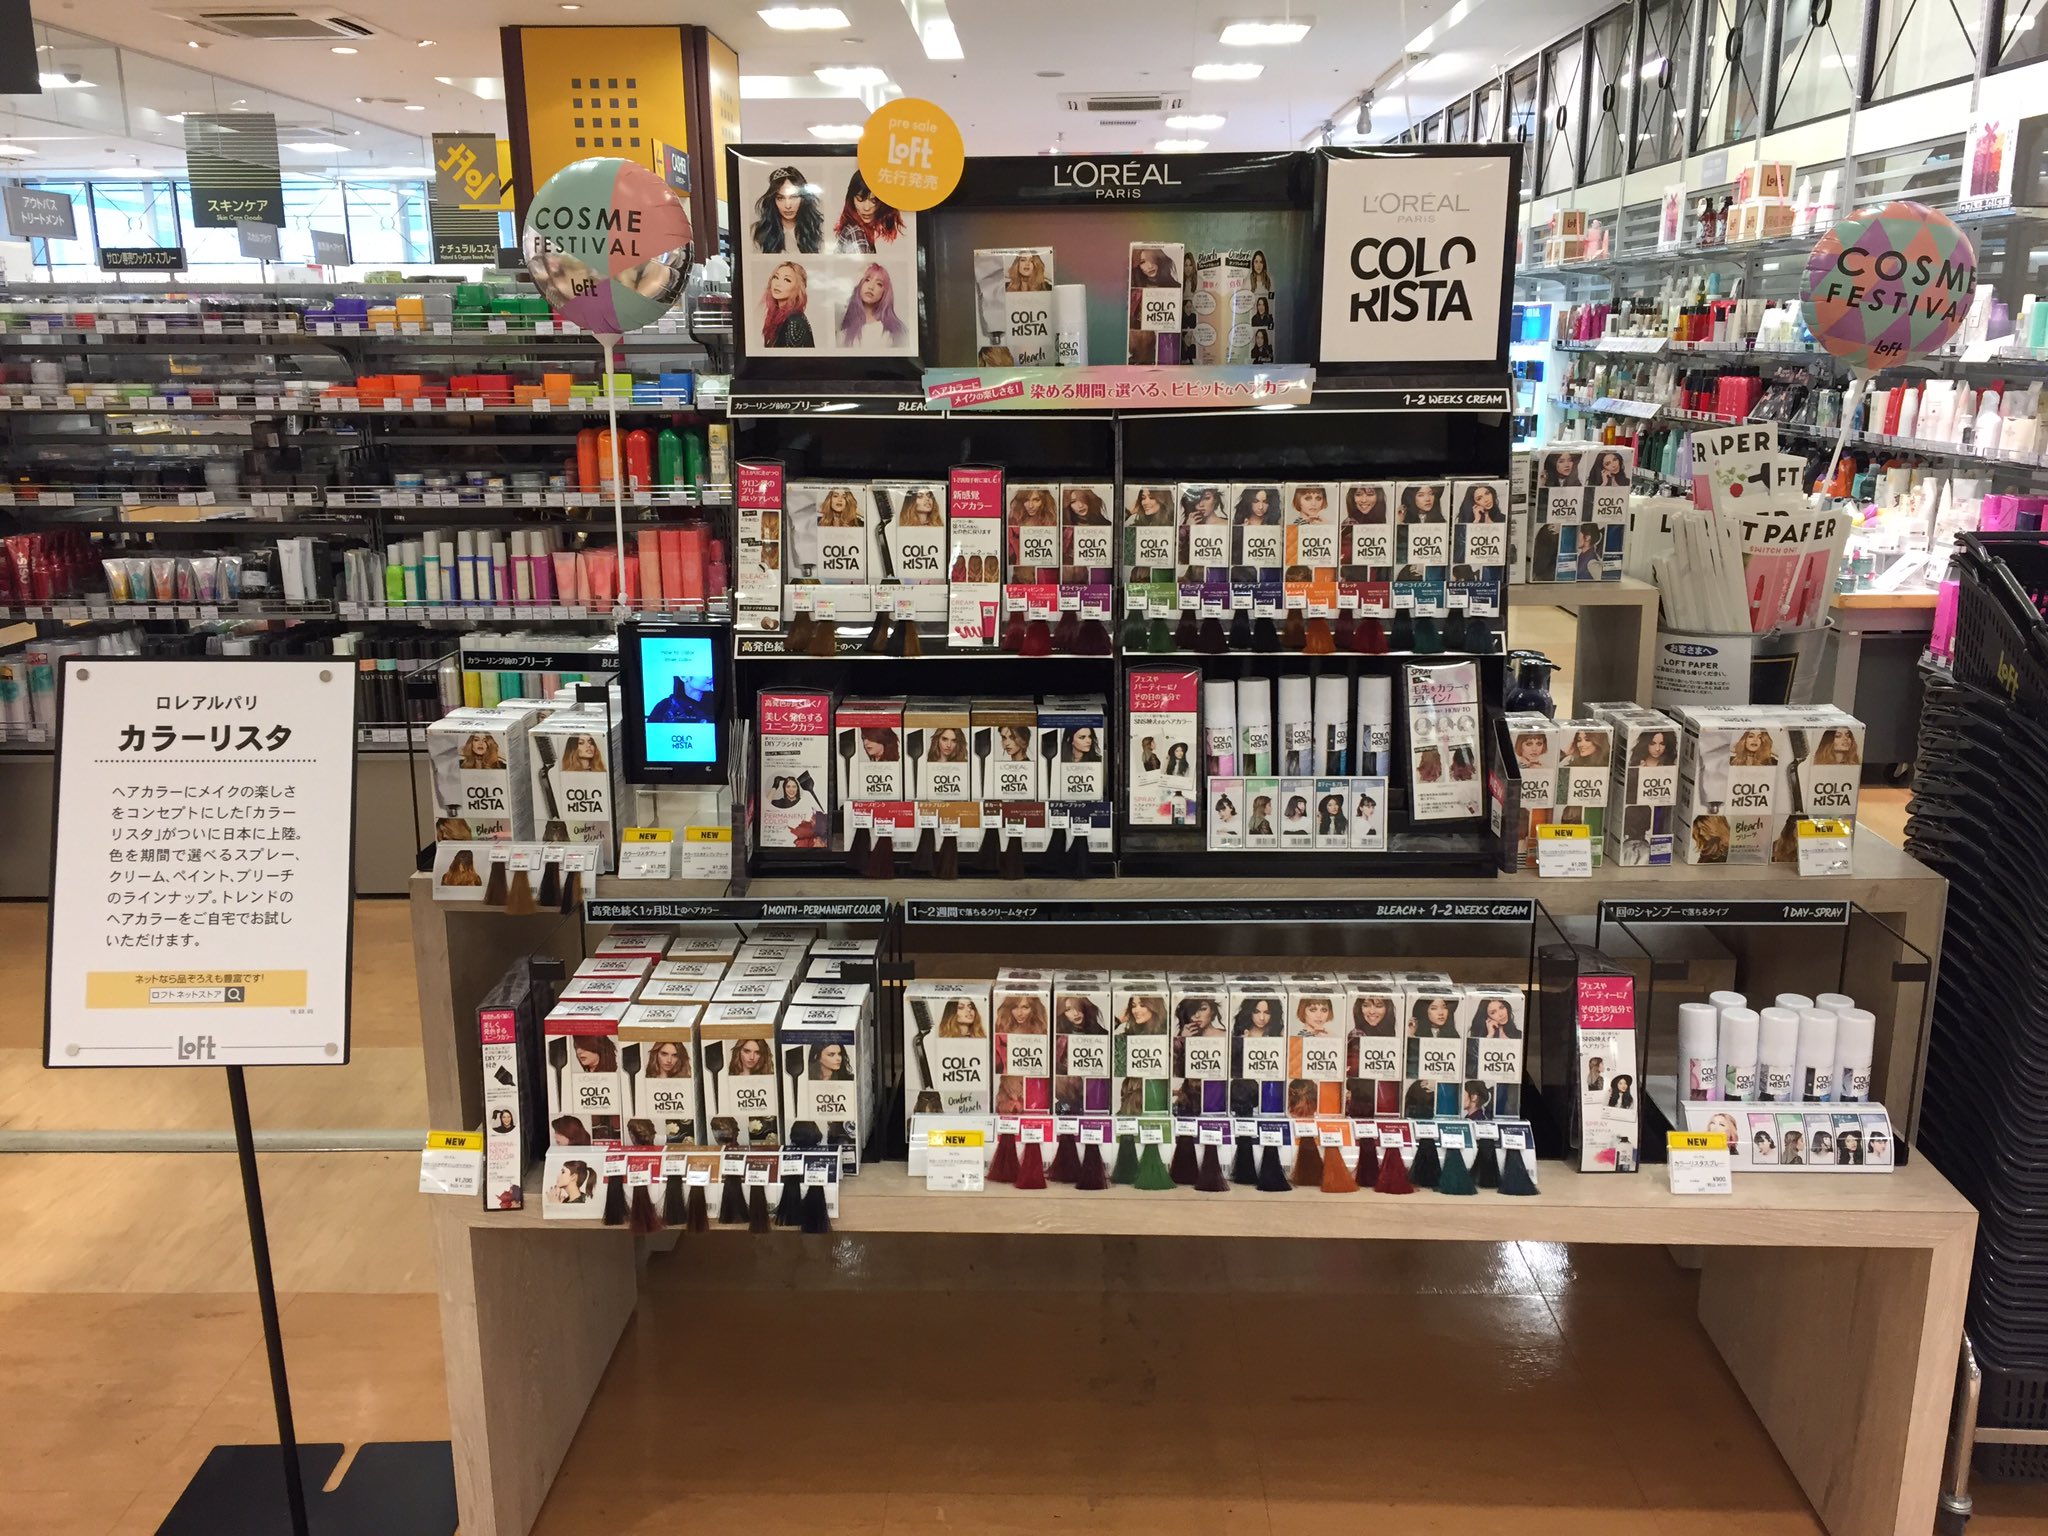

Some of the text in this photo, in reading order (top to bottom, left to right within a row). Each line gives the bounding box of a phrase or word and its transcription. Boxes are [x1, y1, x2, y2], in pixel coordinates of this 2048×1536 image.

[888, 118, 938, 134] pre sale
[878, 167, 939, 190] 先行発売
[1054, 161, 1182, 188] L'ORÉAL
[22, 196, 58, 211] アウトバス
[208, 200, 268, 212] スキンケア
[1363, 192, 1470, 214] L'ORÉAL
[21, 212, 65, 227] トリートメント
[535, 206, 641, 233] COSME
[534, 236, 640, 257] FESTIVAL
[1351, 236, 1476, 280] COLO
[1837, 247, 1976, 295] COSME
[1146, 301, 1176, 312] COLO
[1350, 280, 1473, 322] RISTA
[1010, 311, 1048, 324] COLO
[1403, 394, 1503, 406] 1-2 WEEKS CREAM
[952, 490, 980, 500] 新感覚
[952, 502, 992, 511] ヘアカラー
[1669, 644, 1713, 655] お客さまへ
[467, 656, 553, 667] カラーリング前のブリーチ
[1664, 658, 1719, 669] LOFT PAPER
[1134, 675, 1159, 683] フェスや
[156, 695, 258, 711] ロレアルパリ
[765, 712, 823, 722] 美しく発色する
[765, 722, 824, 732] ユニークカラー
[118, 724, 292, 752] カラーリスタ
[111, 785, 297, 799] ヘアカラーにメイクの楽しさ
[466, 787, 503, 798] COLO
[566, 789, 602, 800] COLO
[1732, 783, 1770, 796] COLO
[1814, 782, 1852, 795] COLO
[111, 806, 297, 820] をコンセプトにした「カラー
[1735, 818, 1764, 834] Bleach
[1814, 824, 1834, 833] NEW
[111, 826, 302, 842] リスタ」がついに日本に上陸。
[638, 832, 658, 840] NEW
[700, 831, 719, 839] NEW
[1554, 829, 1573, 837] NEW
[109, 848, 301, 863] 色を期間で選べるスプレー、
[109, 869, 295, 884] クリーム、ペイント、ブリーチ
[107, 890, 294, 905] のラインナップ。トレンドの
[592, 905, 720, 917] 高発色続く1ヶ月以上のヘアカラー
[853, 904, 882, 915] COLOR
[1431, 904, 1453, 916] 1-2
[1455, 904, 1489, 916] WEEKS
[1491, 905, 1528, 916] CREAM
[1790, 907, 1843, 918] DAY-SPRAY
[106, 912, 293, 926] ヘアカラーをご自宅でお試し
[105, 933, 201, 948] いただけます。
[135, 974, 265, 984] ネットなら品ぞろえも豊富です!
[1580, 982, 1608, 990] フェスや
[1580, 991, 1628, 1000] パーティーに!
[1581, 1005, 1633, 1014] その日の気分で
[1582, 1014, 1614, 1022] チェンジ!
[445, 1137, 467, 1146] NEW
[945, 1135, 966, 1144] NEW
[1687, 1137, 1708, 1147] NEW
